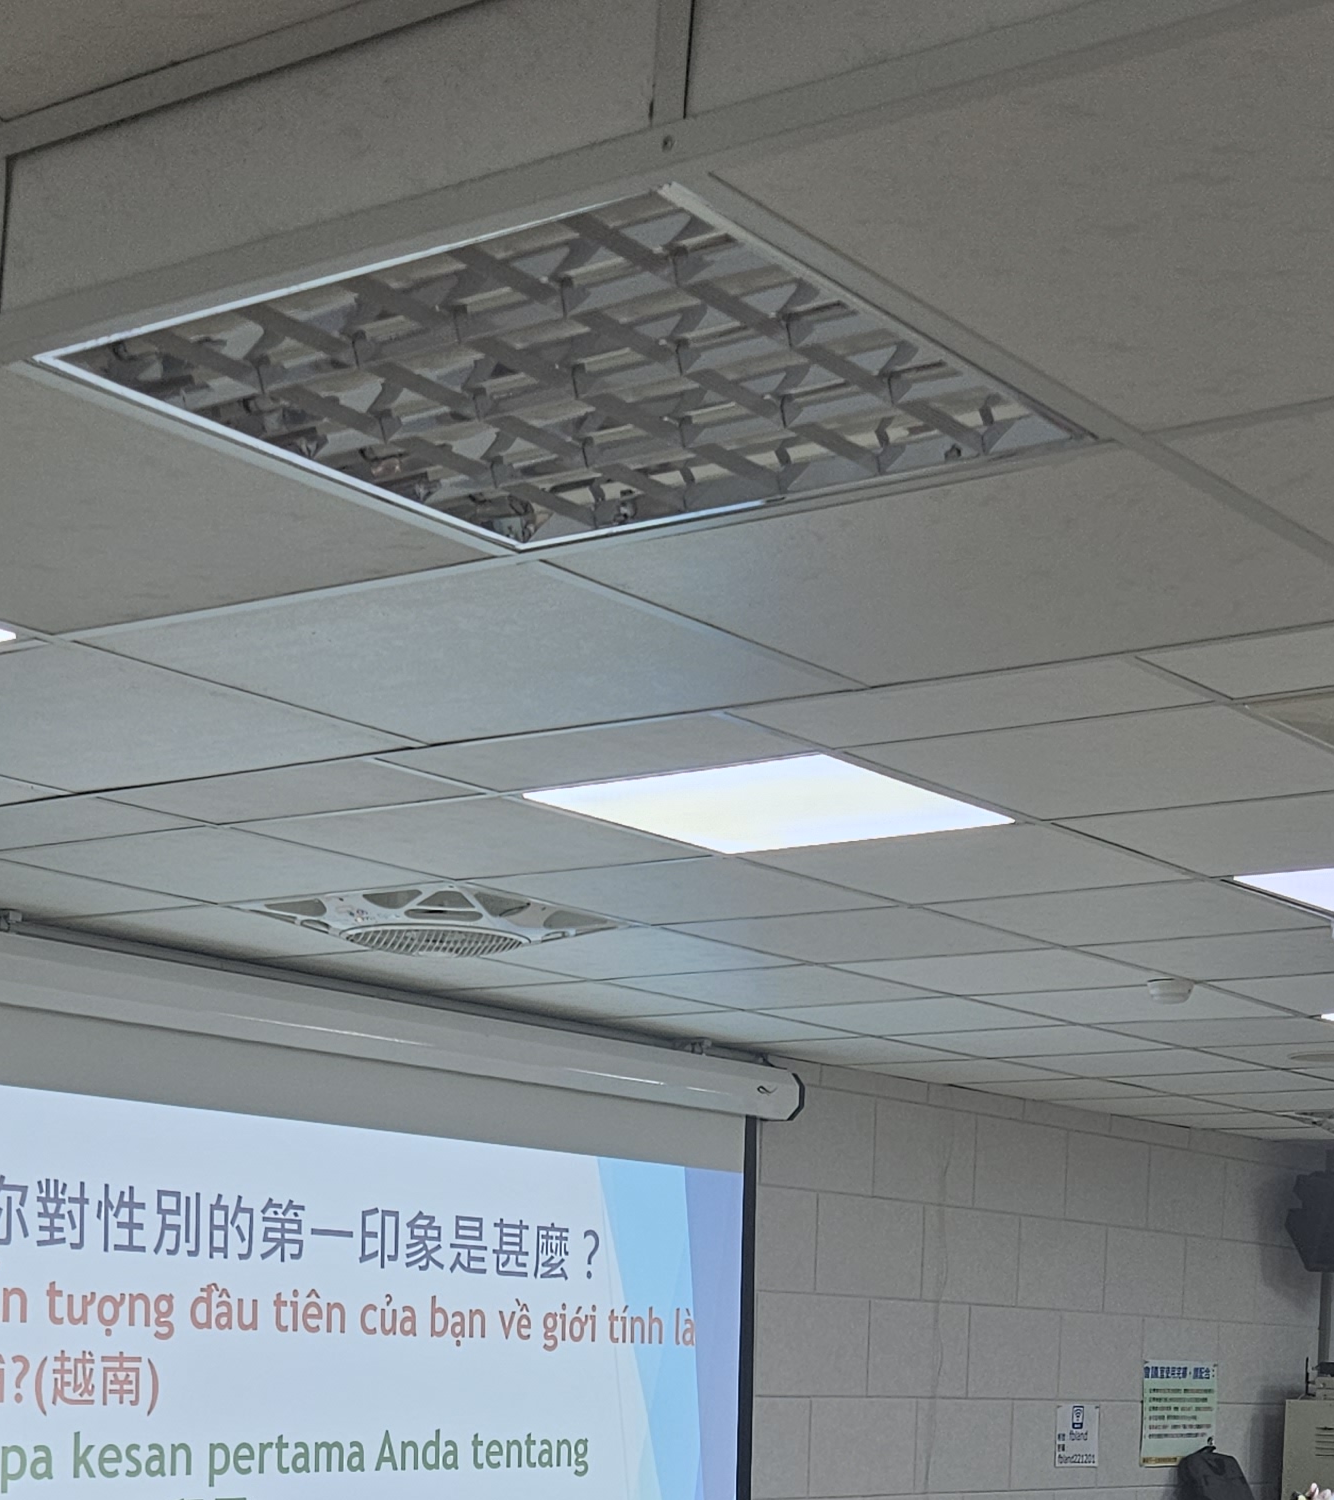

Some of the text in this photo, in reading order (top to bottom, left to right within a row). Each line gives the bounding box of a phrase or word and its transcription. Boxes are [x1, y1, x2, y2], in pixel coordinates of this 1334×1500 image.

[46, 1280, 175, 1341] tượng
[190, 1282, 259, 1332] đầu
[273, 1288, 347, 1334] tiên
[360, 1293, 417, 1337] của
[430, 1295, 487, 1347] bạn
[498, 1298, 532, 1341] về
[542, 1302, 597, 1352] giới
[608, 1304, 664, 1346] tính
[674, 1307, 696, 1347] là
[72, 1431, 193, 1479] kesan
[208, 1434, 365, 1488] pertama
[374, 1428, 459, 1472] Anda
[471, 1432, 589, 1478] tentang
